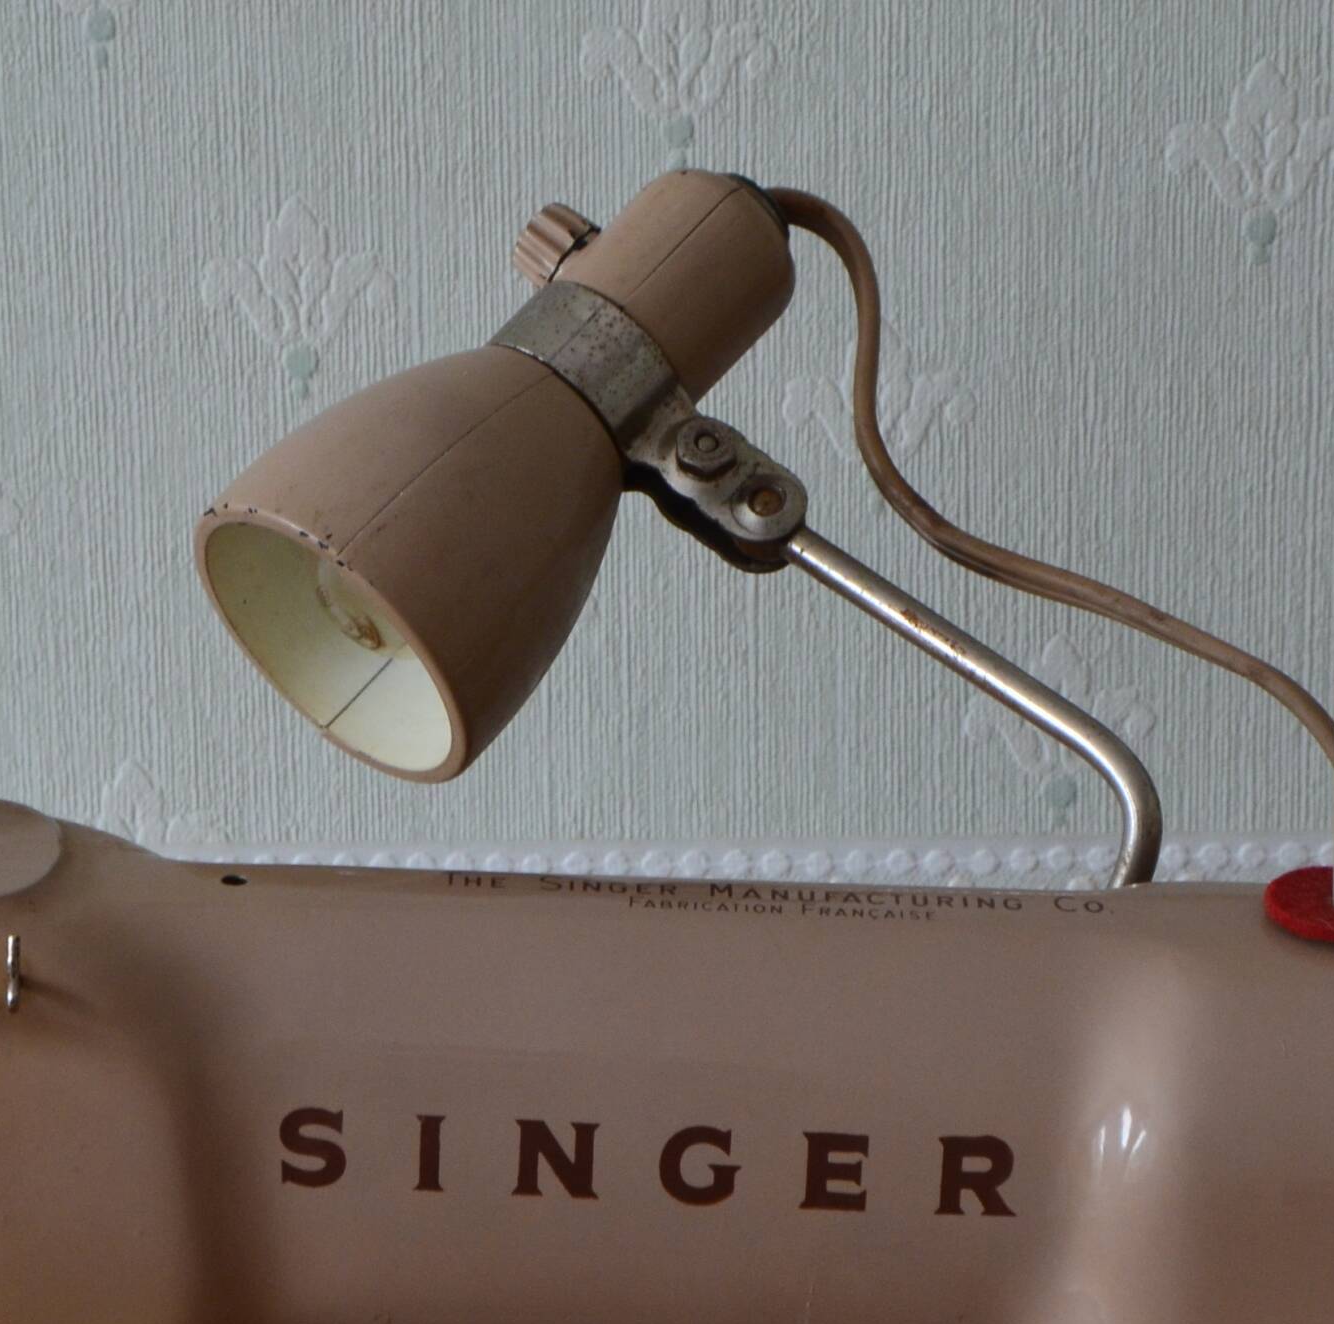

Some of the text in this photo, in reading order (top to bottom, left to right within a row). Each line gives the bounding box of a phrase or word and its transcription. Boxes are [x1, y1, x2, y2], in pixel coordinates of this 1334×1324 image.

[445, 872, 508, 889] THE
[539, 876, 678, 896] SINGER
[709, 883, 1023, 911] MANUFACTURING
[628, 896, 937, 921] FABRICATION FRANÇAISE
[278, 1106, 1018, 1218] SINGER
